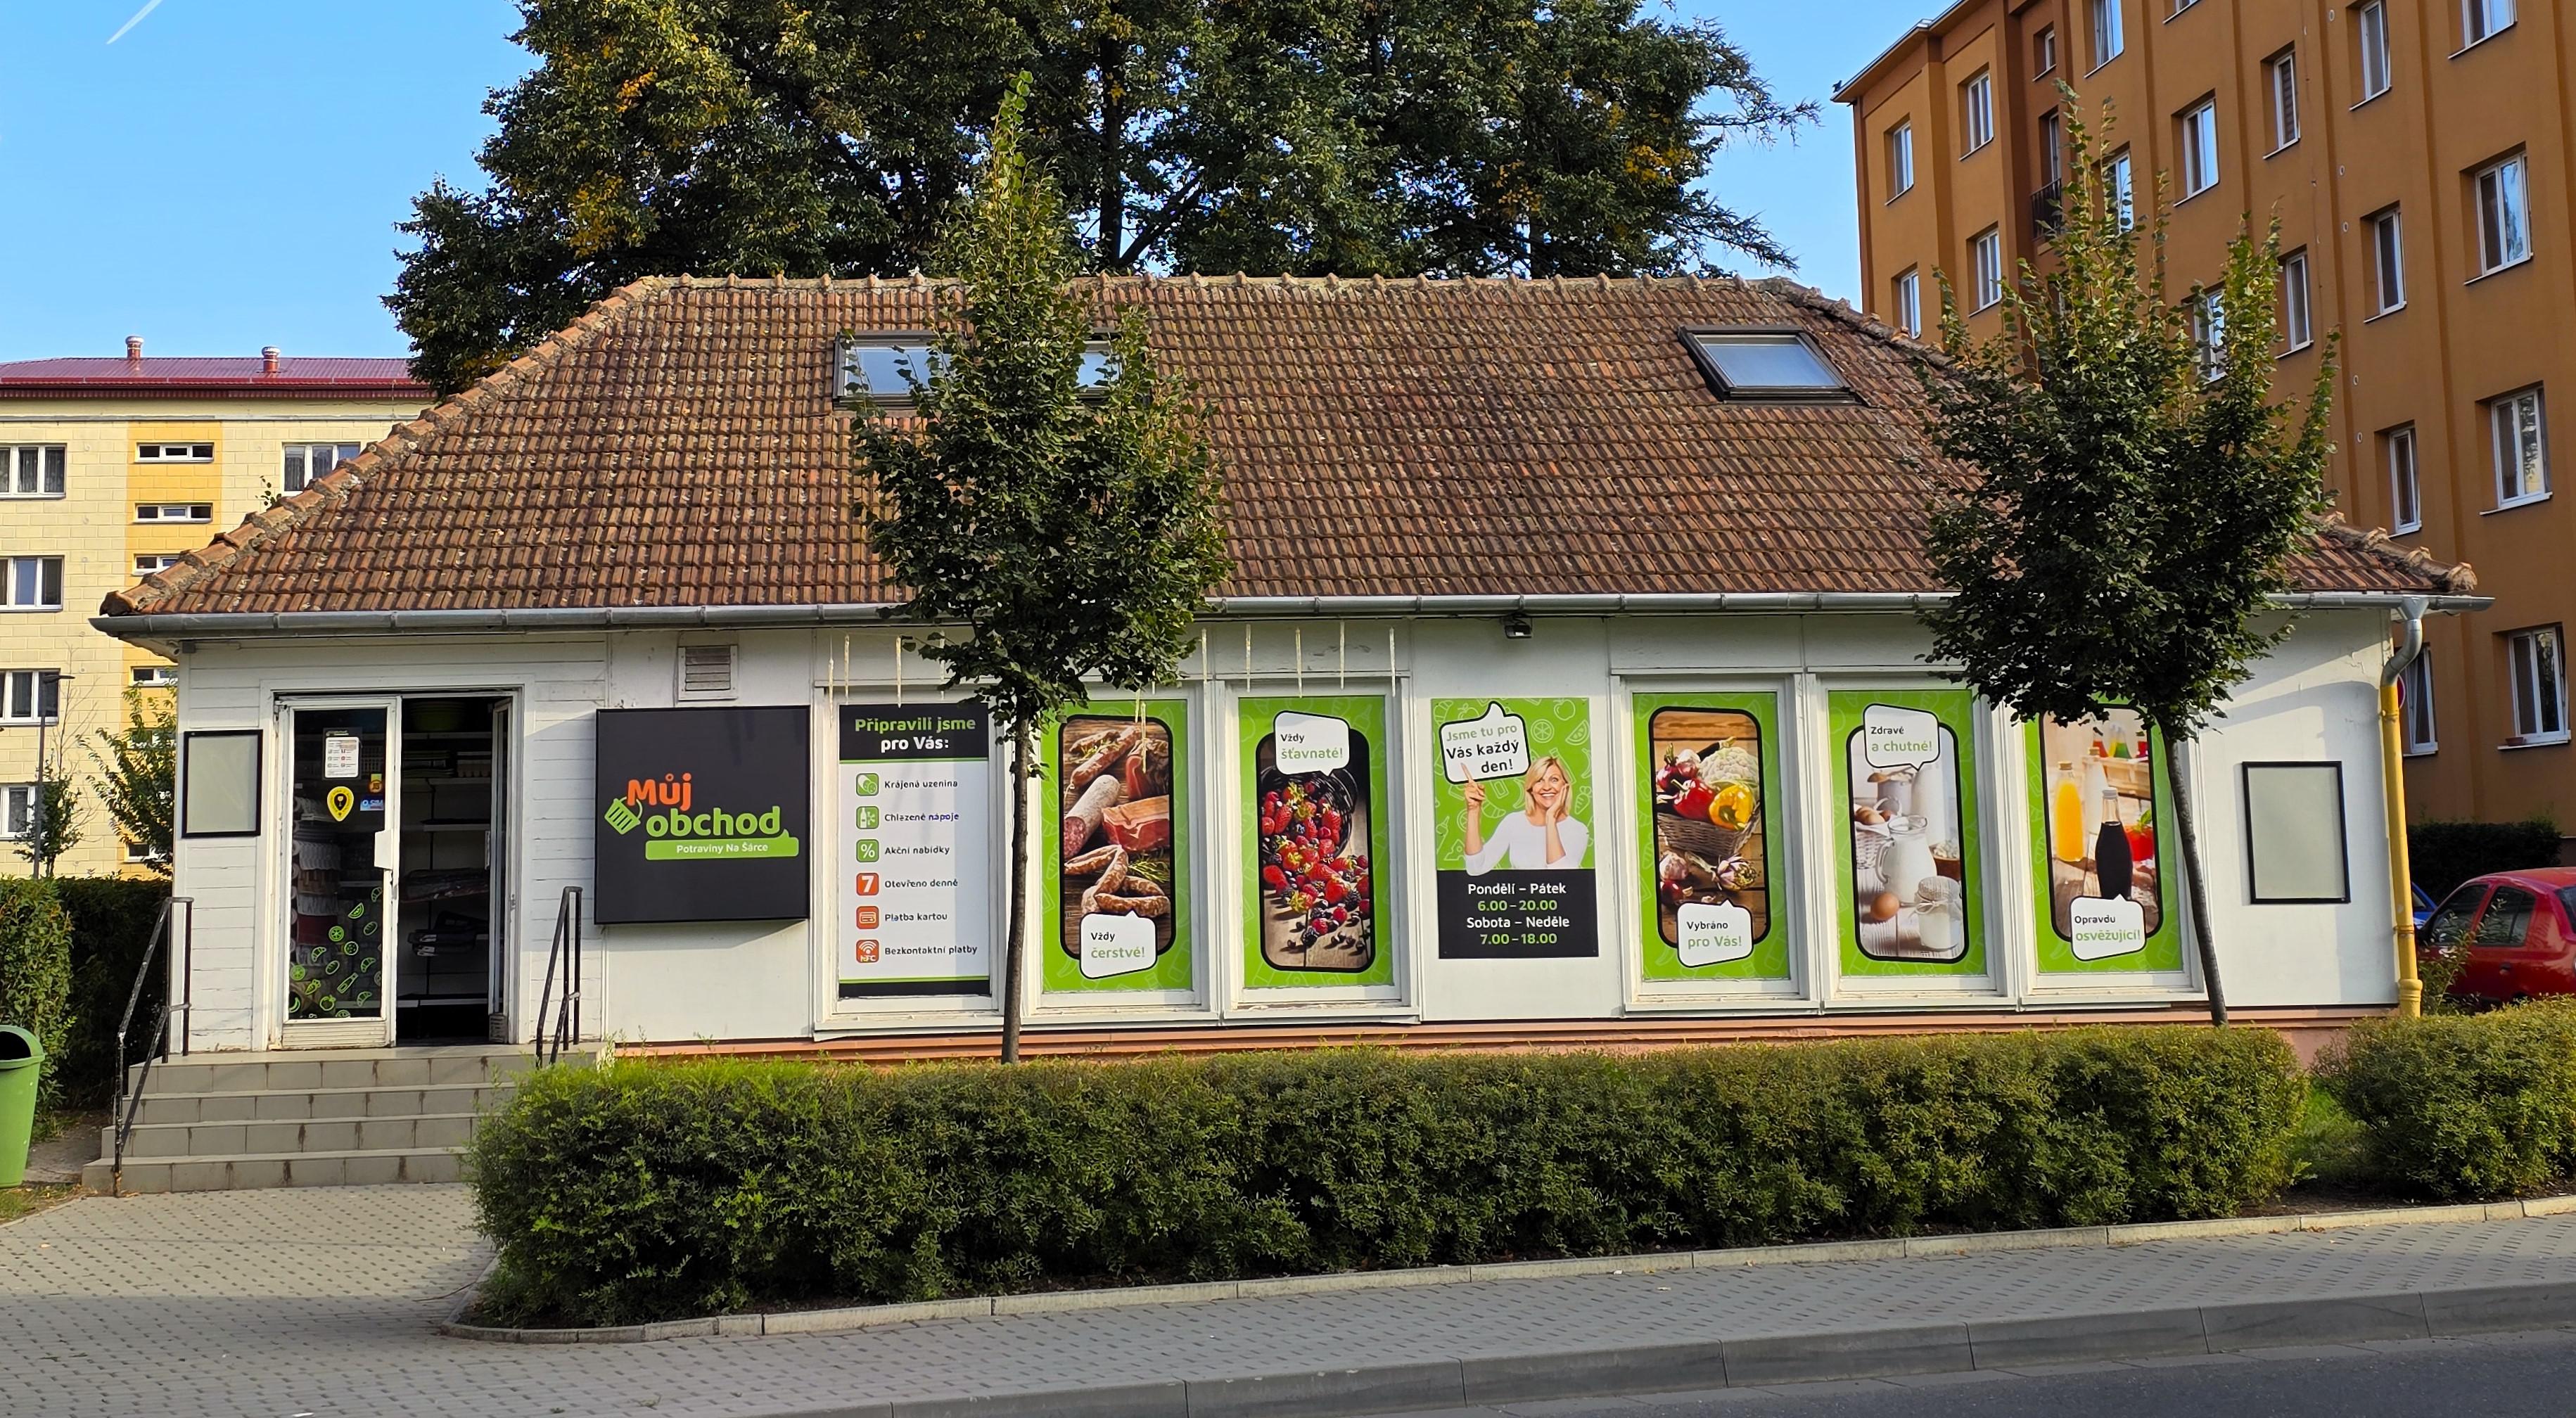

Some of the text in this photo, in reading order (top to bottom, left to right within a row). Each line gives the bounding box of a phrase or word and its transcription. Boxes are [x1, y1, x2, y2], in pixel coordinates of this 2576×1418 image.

[855, 717, 976, 734] Připravili jsme
[1870, 726, 1904, 734] Zdravé
[1280, 733, 1305, 743] Vždy
[1446, 725, 1517, 741] Jsme tu pro
[881, 736, 949, 753] pro Vás:
[1446, 739, 1519, 759] Vás každý
[1884, 741, 1932, 751] chutné!
[1281, 747, 1343, 759] šťavnaté!
[1481, 758, 1513, 773] den!
[923, 779, 958, 788] uzenina
[627, 772, 691, 811] Můj
[646, 805, 780, 837] obchod
[884, 813, 959, 822] Chlazené nápoje
[676, 845, 723, 855] Potraviny
[741, 842, 768, 852] Šárce
[913, 846, 950, 855] nabídky
[861, 875, 874, 893] 7
[930, 879, 958, 887] denně
[1468, 883, 1515, 895] Pondělí
[1530, 882, 1567, 894] Pátek
[885, 913, 914, 921] Platba
[1467, 916, 1511, 928] Sobota
[1526, 916, 1570, 928] Neděle
[2074, 914, 2116, 925] Opravdu
[1686, 921, 1728, 931] Vybráno
[1090, 932, 1115, 943] Vždy
[2075, 929, 2141, 943] osvěžující!
[1688, 935, 1742, 950] pro Vás!
[885, 945, 978, 955] Bezkontaktní platby
[1091, 947, 1144, 958] čerstvé!
